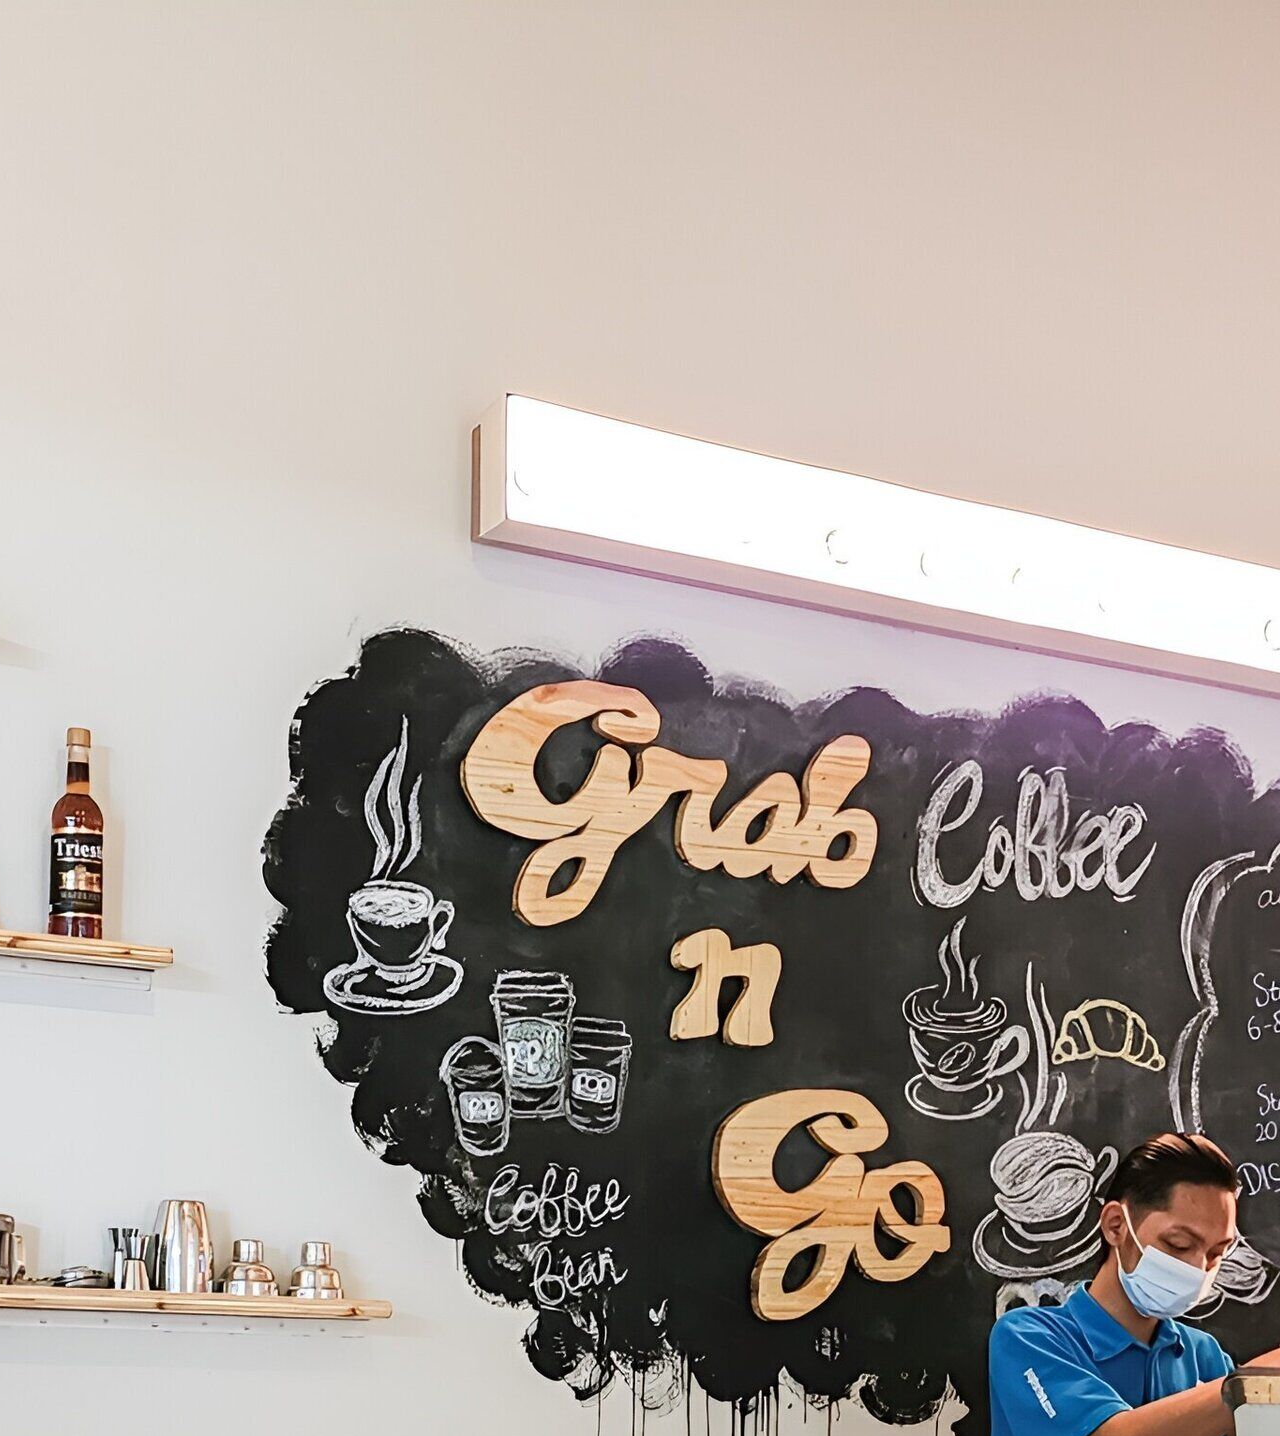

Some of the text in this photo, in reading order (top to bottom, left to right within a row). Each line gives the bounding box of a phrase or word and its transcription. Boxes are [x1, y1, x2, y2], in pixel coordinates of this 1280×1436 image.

[460, 679, 879, 927] Grab
[912, 760, 1158, 909] Coffee
[669, 928, 782, 1047] n
[484, 1164, 631, 1237] Coffee
[712, 1087, 951, 1321] Go
